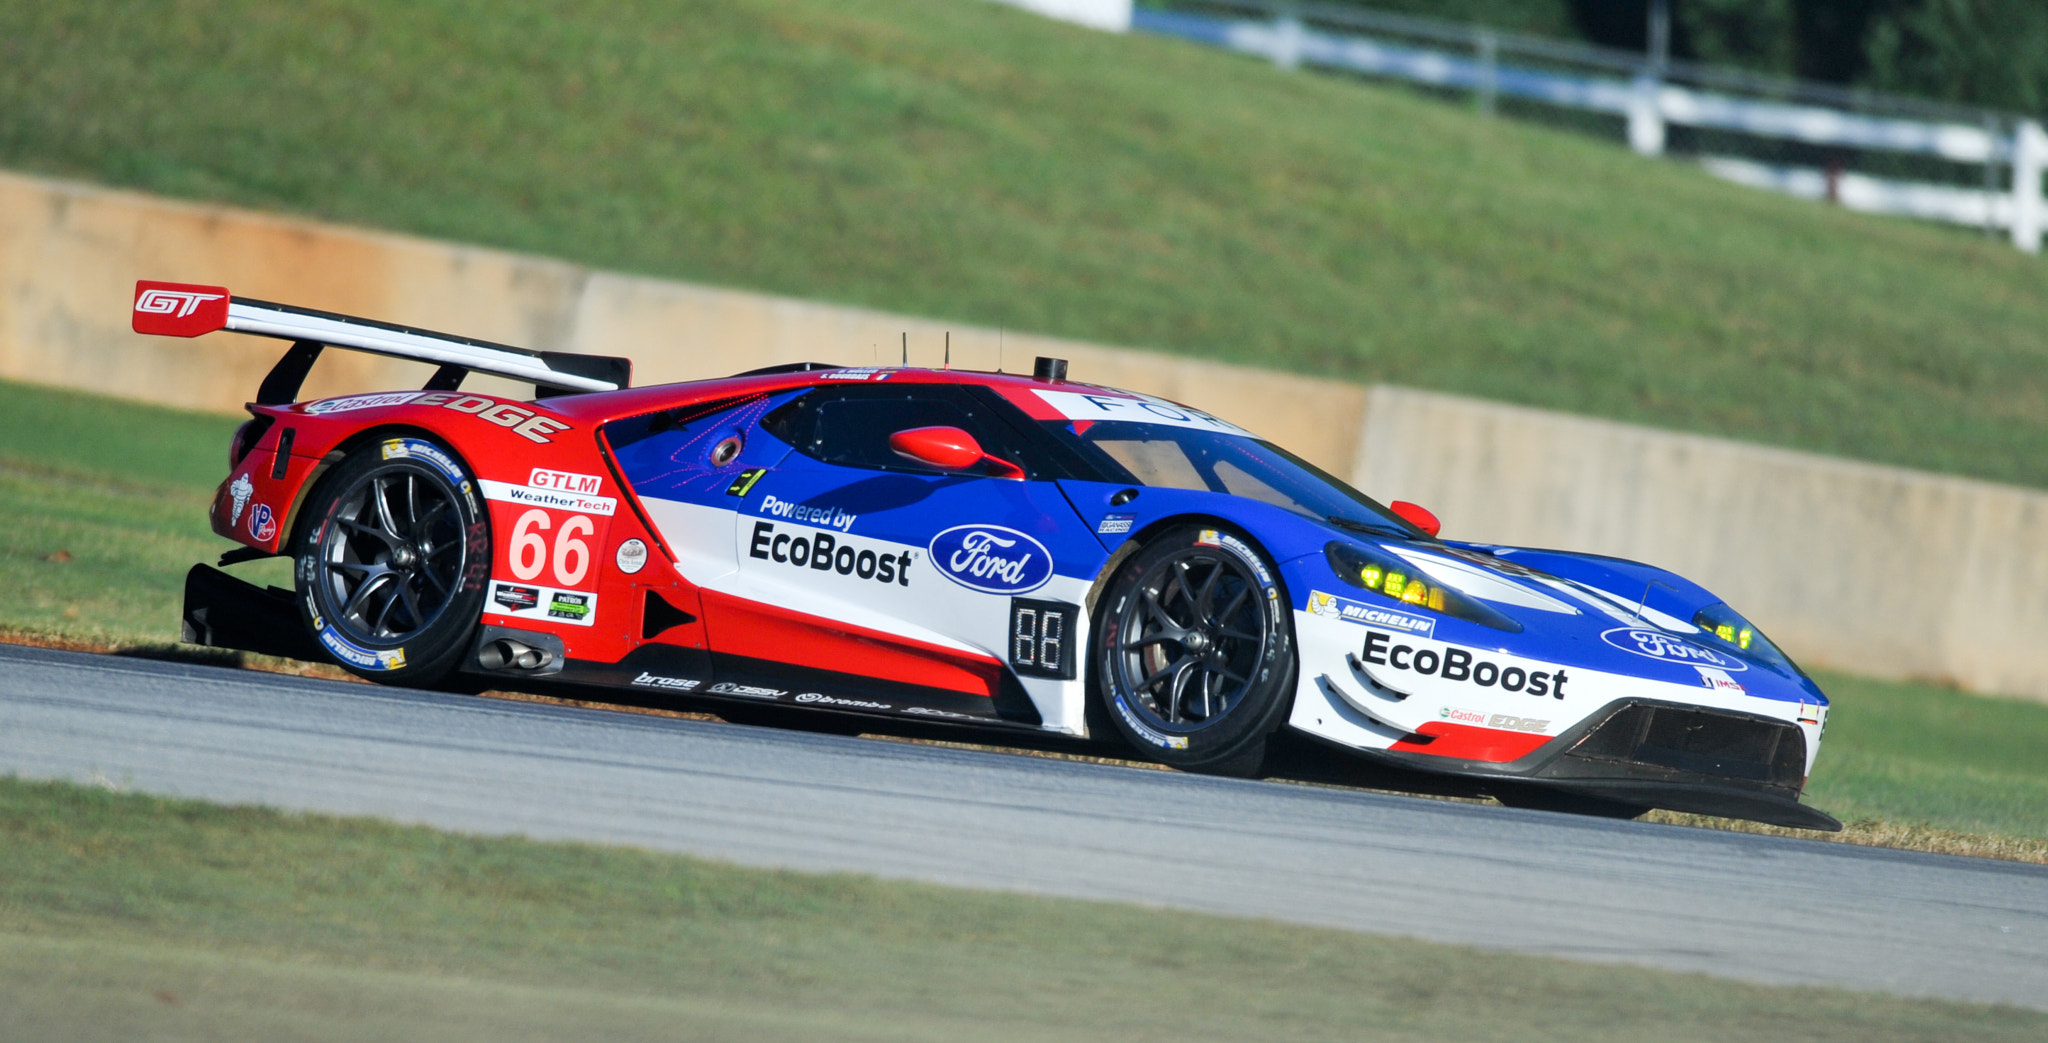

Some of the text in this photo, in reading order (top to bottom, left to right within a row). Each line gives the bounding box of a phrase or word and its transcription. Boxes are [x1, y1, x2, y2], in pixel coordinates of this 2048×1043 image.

[135, 289, 225, 318] GT
[331, 393, 573, 444] Castrol EDGE
[1082, 394, 1234, 430] FOR
[410, 443, 464, 479] MICHELIN
[510, 489, 611, 511] WeatherTech
[532, 471, 597, 493] GTLM
[760, 495, 857, 532] Powered by
[509, 509, 594, 586] 66
[749, 521, 913, 587] EcoBoost
[950, 531, 1032, 585] Ford
[1221, 534, 1272, 583] MICHELIN
[1342, 604, 1431, 632] MICHELIN
[323, 631, 378, 667] MICHELIN
[1362, 630, 1569, 701] EcoBoost
[1629, 630, 1726, 665] Ford
[634, 671, 701, 688] brose
[818, 694, 892, 709] brembo
[1450, 709, 1551, 733] Castrol EDGE
